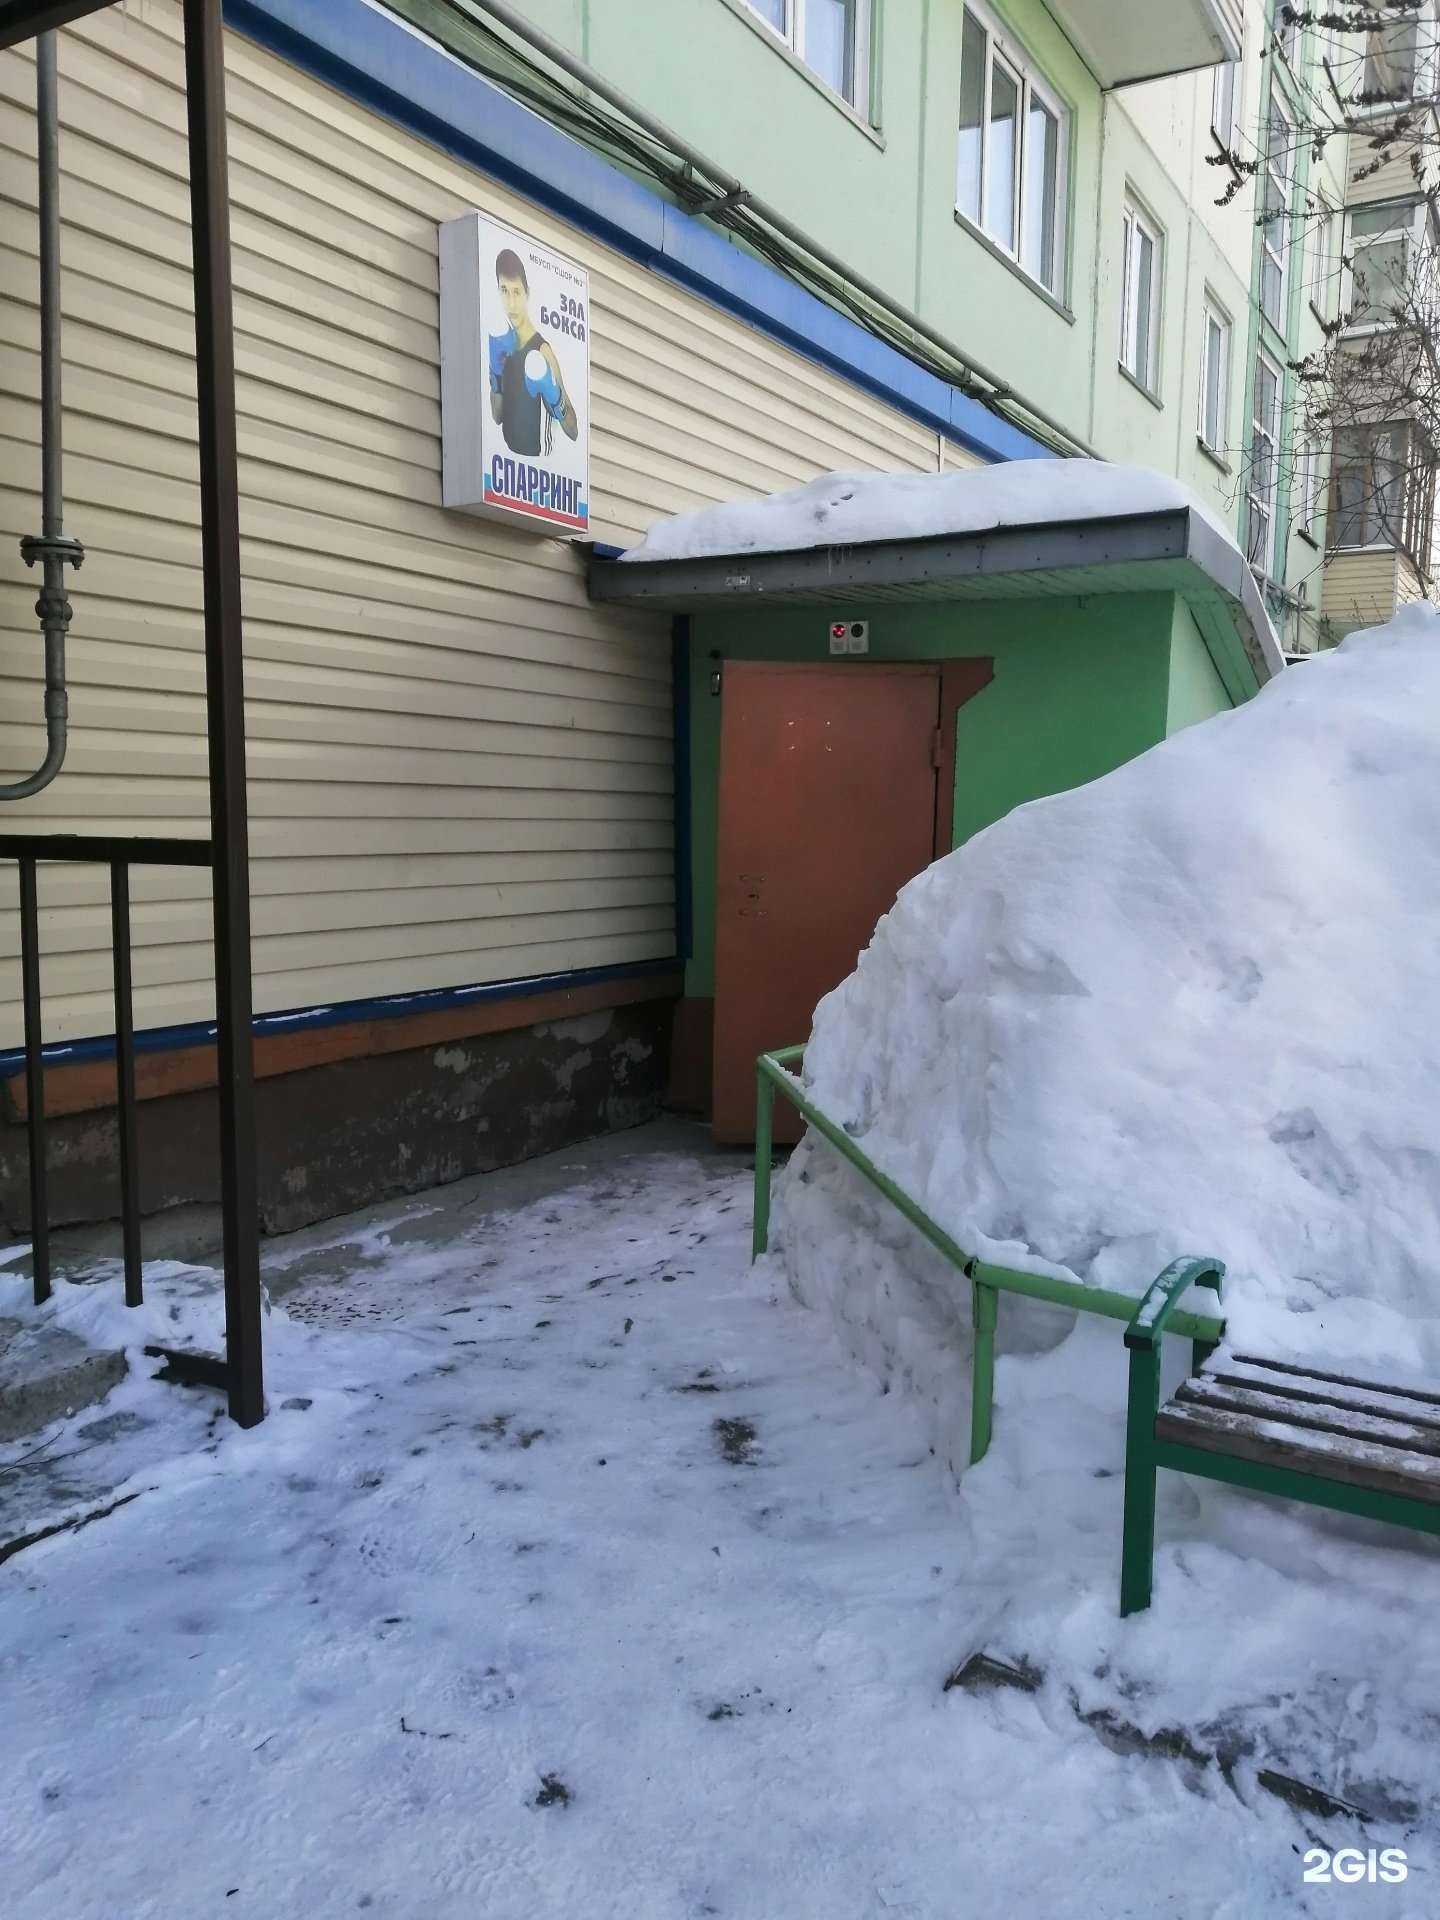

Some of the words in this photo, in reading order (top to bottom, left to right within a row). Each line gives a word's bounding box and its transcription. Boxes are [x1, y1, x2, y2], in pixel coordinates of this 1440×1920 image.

[540, 306, 586, 342] БОКСА
[560, 293, 585, 322] ЗАЛ
[491, 454, 583, 516] СПАРРИНГ
